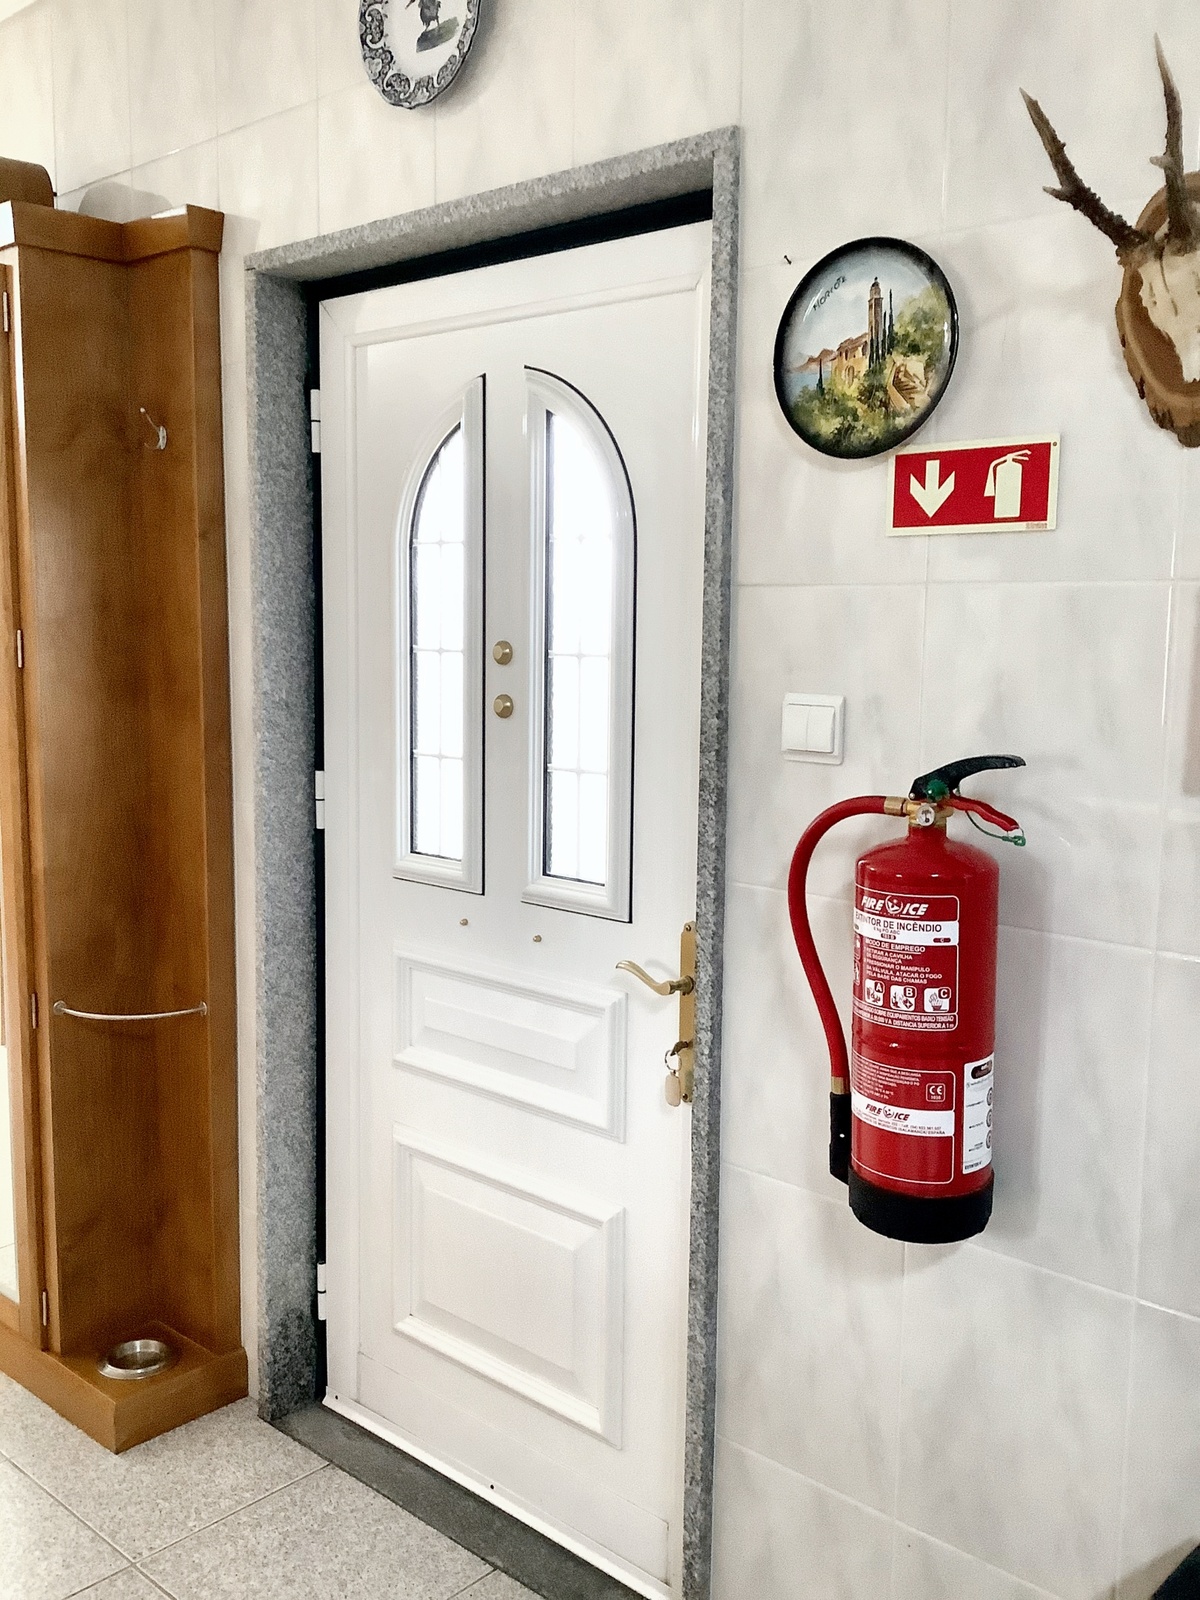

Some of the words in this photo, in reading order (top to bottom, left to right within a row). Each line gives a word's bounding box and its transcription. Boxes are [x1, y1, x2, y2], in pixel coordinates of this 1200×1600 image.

[861, 896, 884, 911] FIRE
[902, 903, 928, 916] ICE
[884, 921, 894, 929] DE
[896, 922, 942, 932] INCÊNDIO
[891, 944, 925, 952] EMPREGO
[876, 983, 883, 992] A
[929, 1085, 942, 1095] CE
[865, 1104, 882, 1115] FIRE
[894, 1113, 910, 1121] ICE
